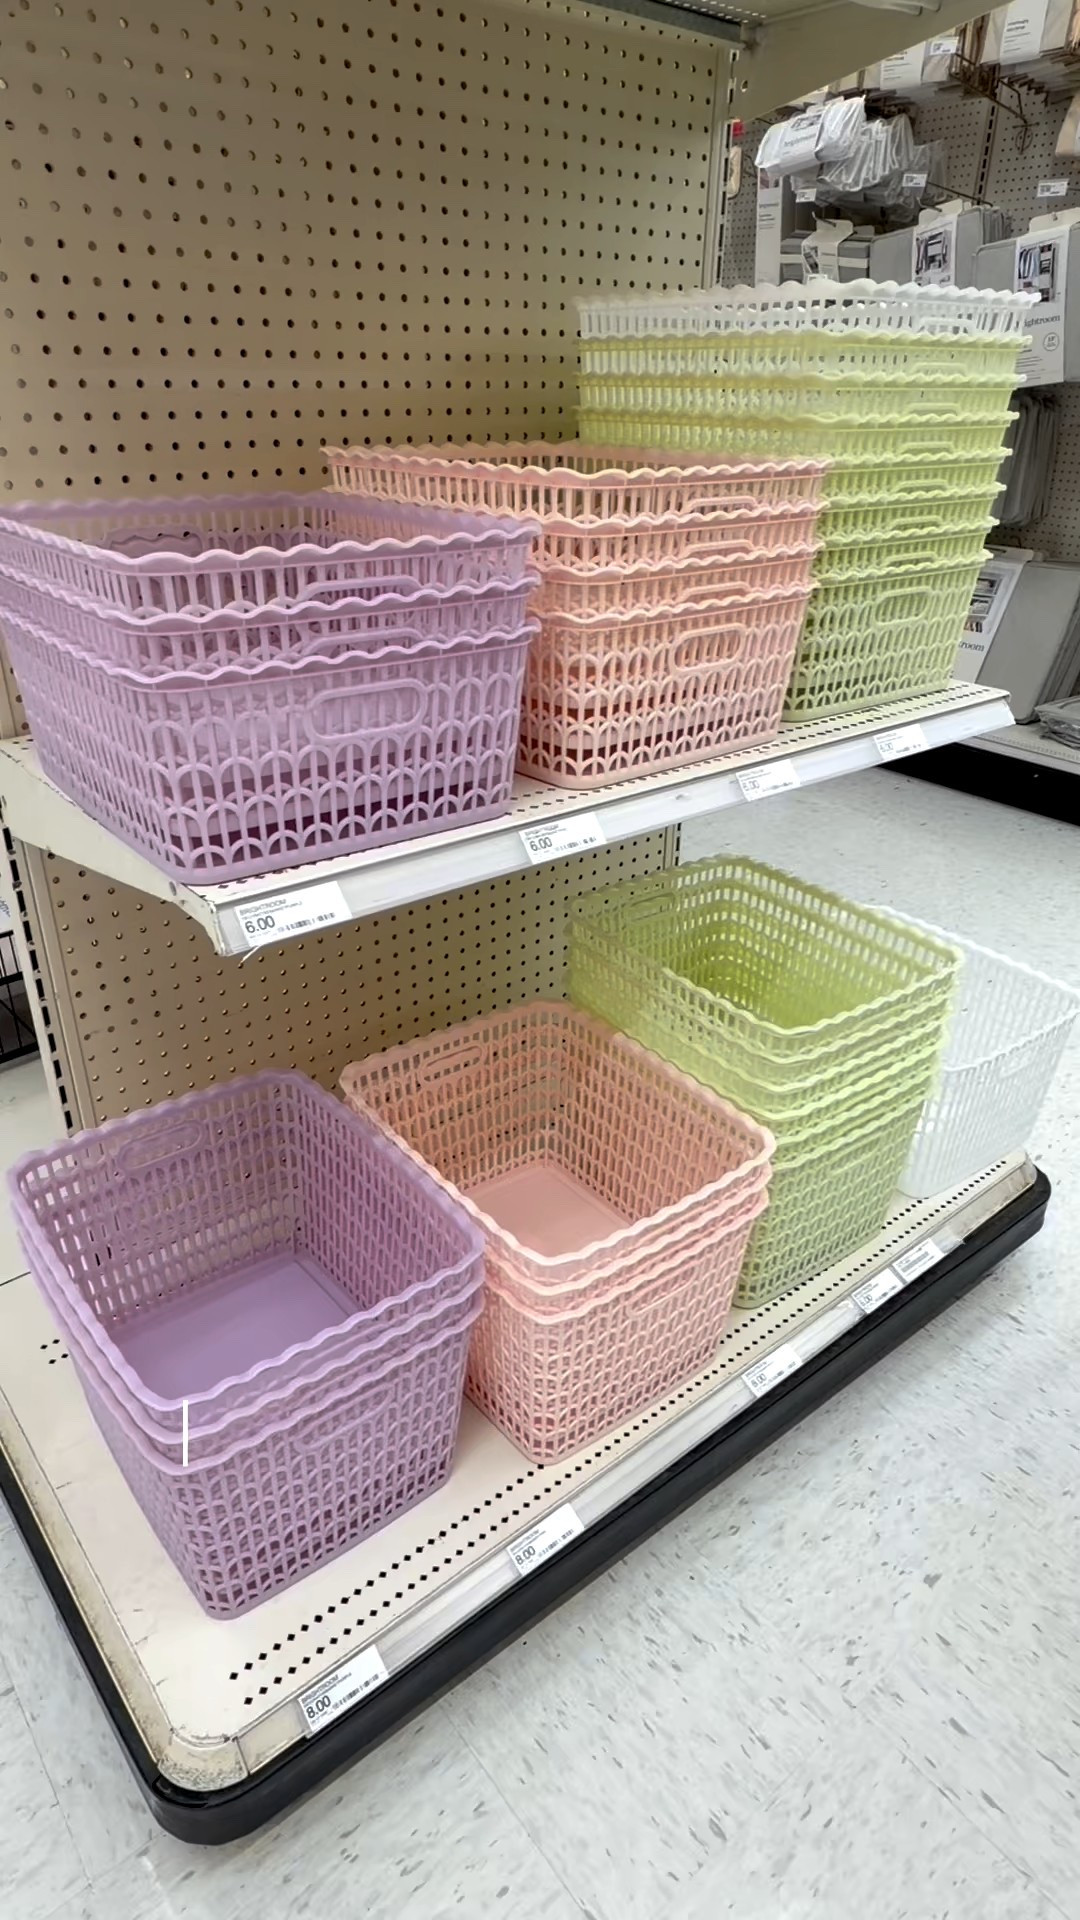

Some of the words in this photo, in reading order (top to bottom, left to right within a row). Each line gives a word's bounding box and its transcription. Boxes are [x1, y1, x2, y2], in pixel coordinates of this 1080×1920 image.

[1024, 314, 1061, 329] ightroom
[529, 836, 553, 853] 6.00
[245, 915, 276, 934] 6.00
[514, 1545, 537, 1565] 8.00
[305, 1695, 332, 1719] 8.00
